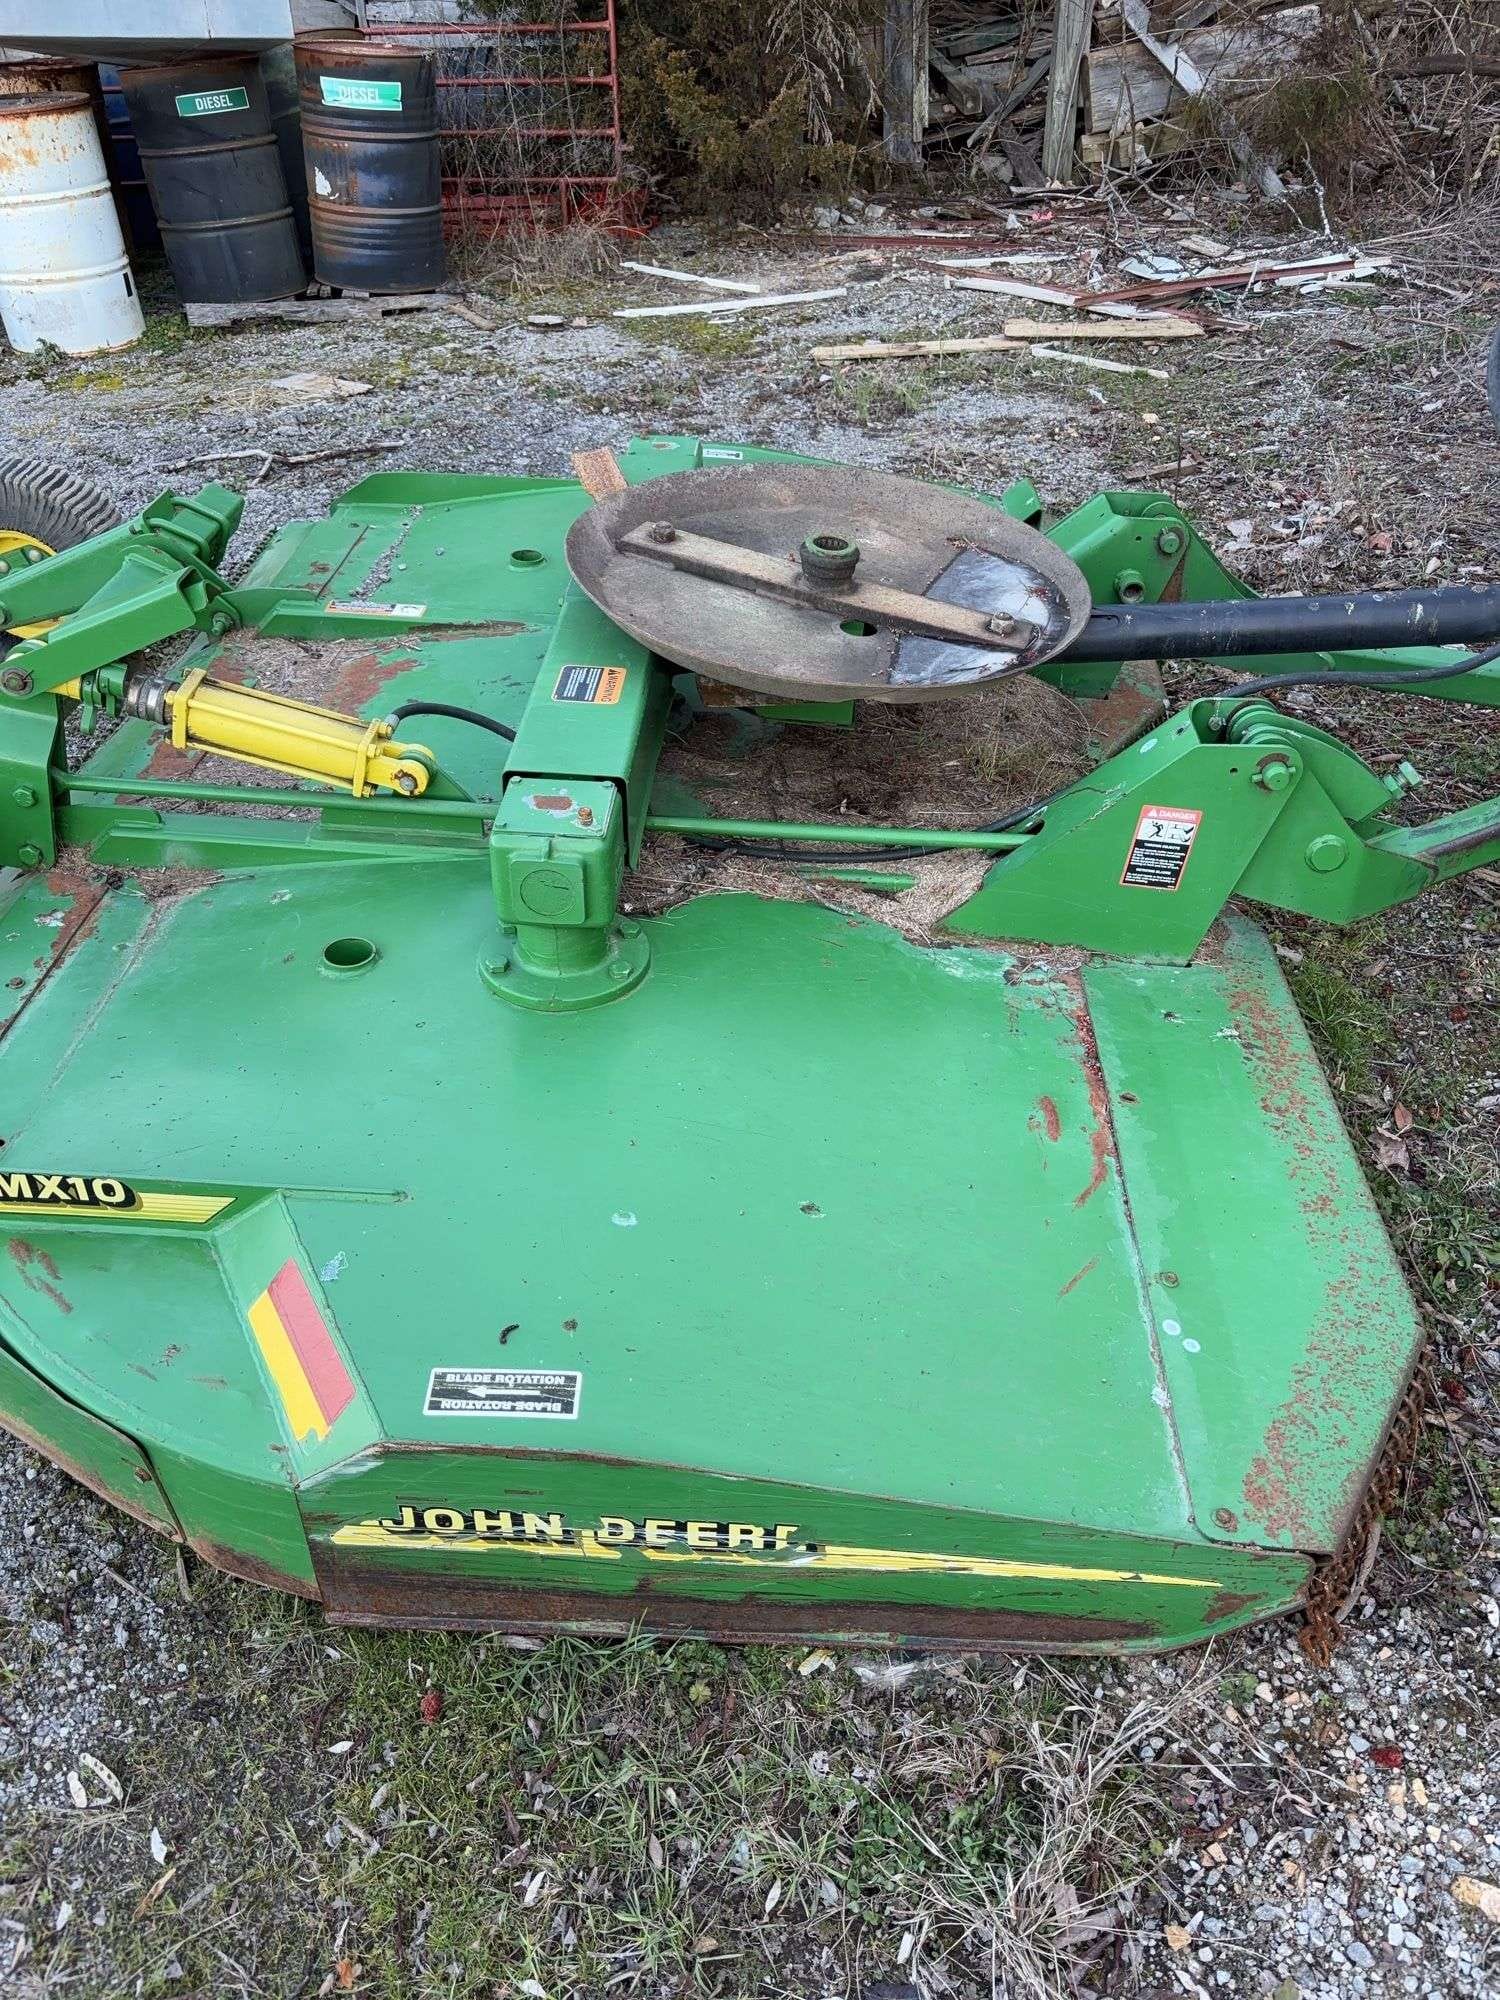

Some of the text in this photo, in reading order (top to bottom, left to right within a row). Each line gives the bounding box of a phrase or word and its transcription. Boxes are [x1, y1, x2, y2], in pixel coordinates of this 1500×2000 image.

[195, 94, 233, 111] DIESEL
[338, 86, 382, 103] DIESEL
[601, 675, 619, 702] WARNING
[1159, 809, 1196, 821] DANGER
[0, 1173, 126, 1203] MX10
[445, 1373, 565, 1384] BLADE ROTATION
[440, 1400, 562, 1412] BLADE ROTATION
[381, 1505, 566, 1540] JOHN
